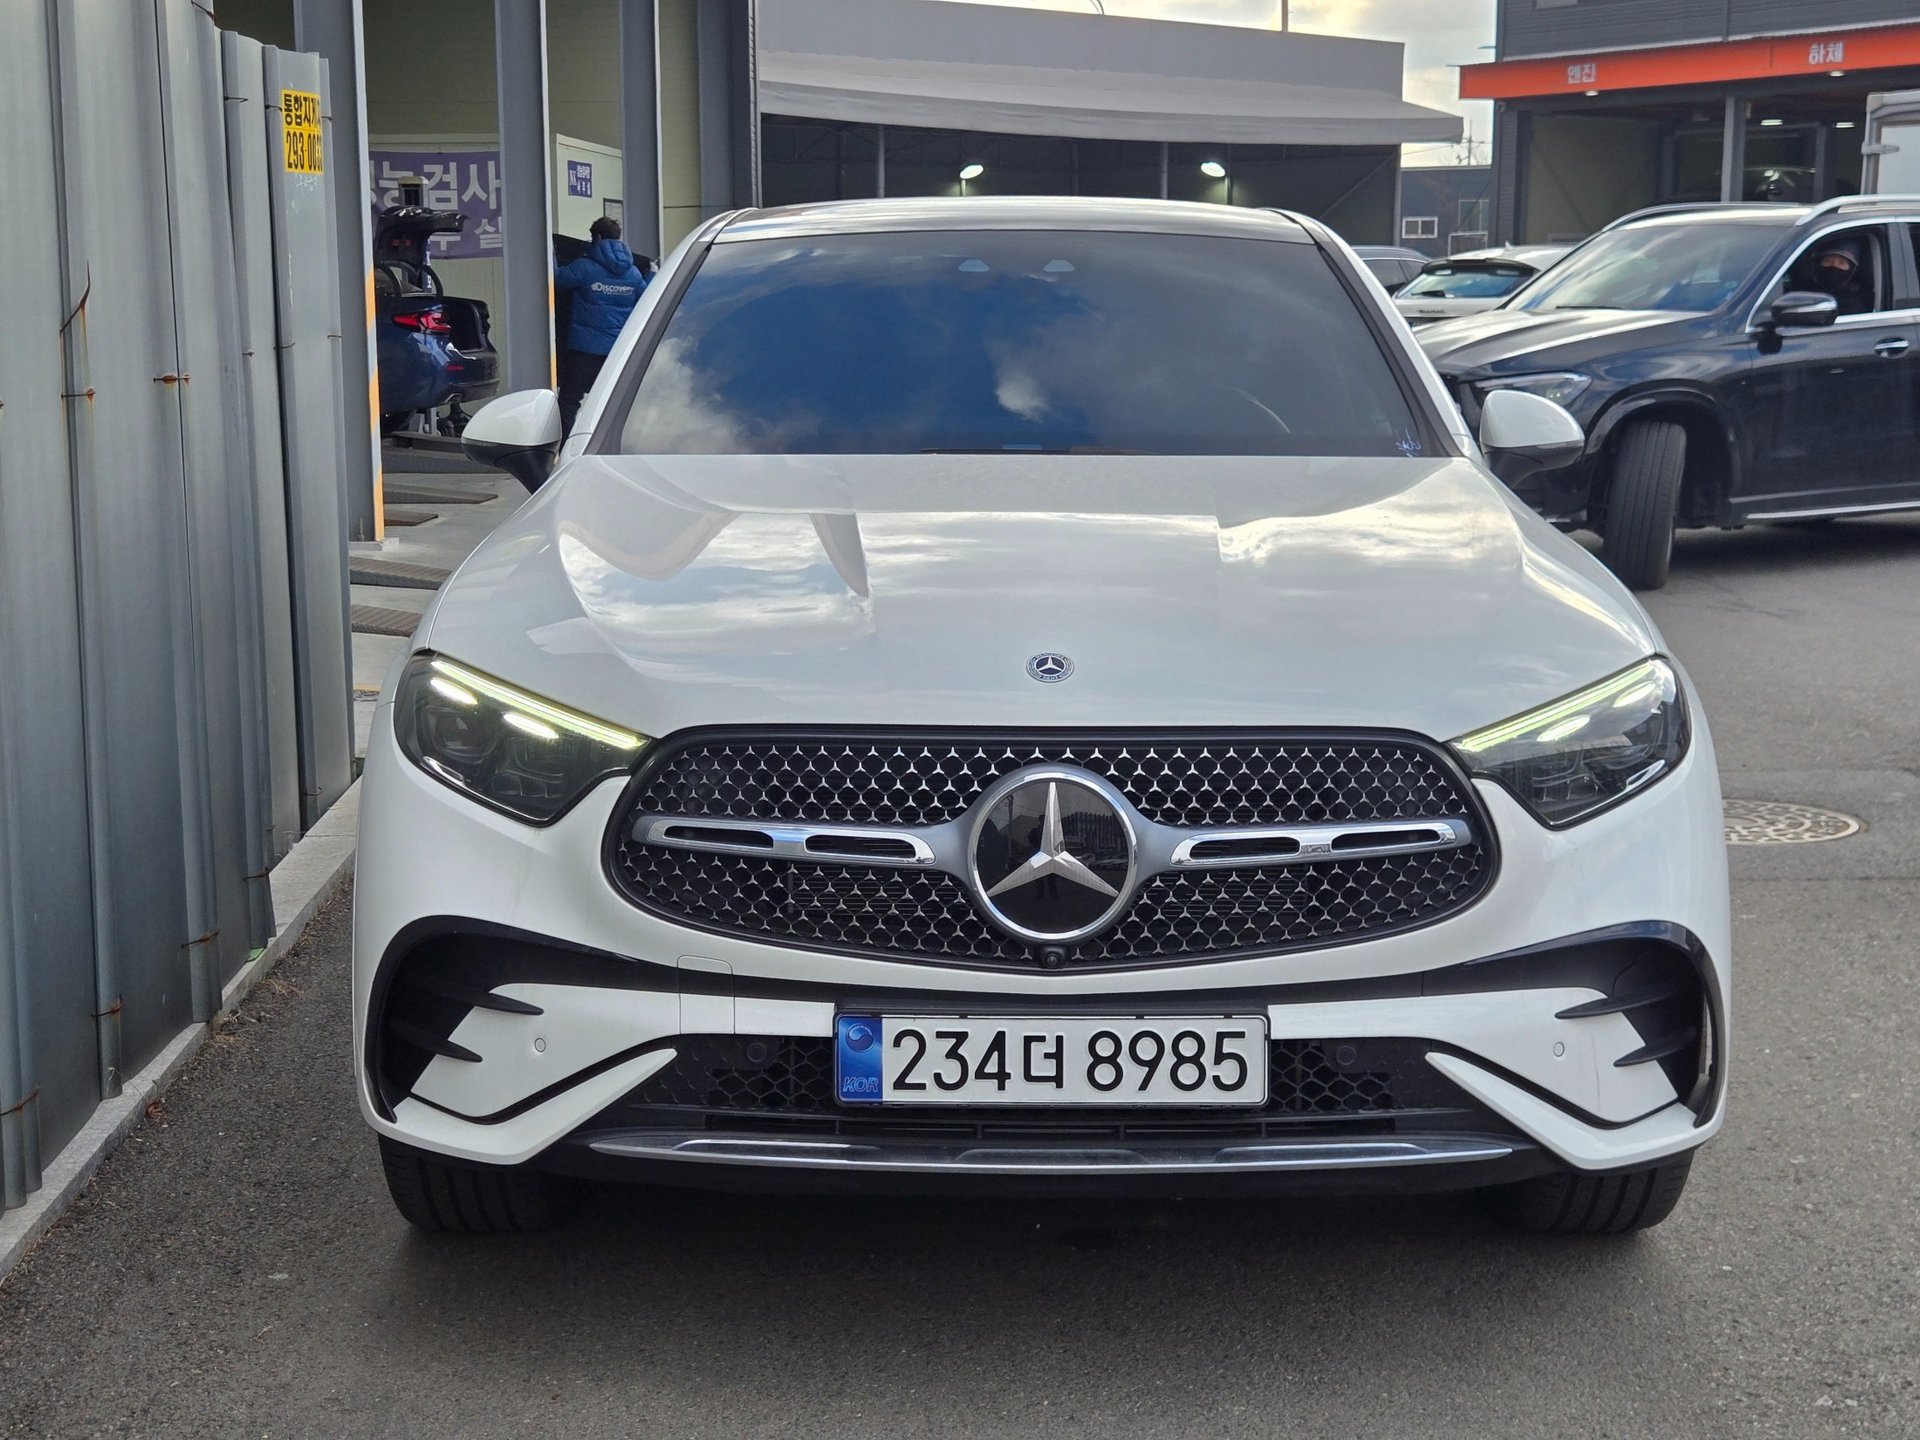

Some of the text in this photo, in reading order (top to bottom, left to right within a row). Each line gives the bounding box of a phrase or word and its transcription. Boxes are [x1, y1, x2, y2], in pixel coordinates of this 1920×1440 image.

[891, 1029, 1249, 1092] 234더 8985
[843, 1076, 879, 1093] KOR
